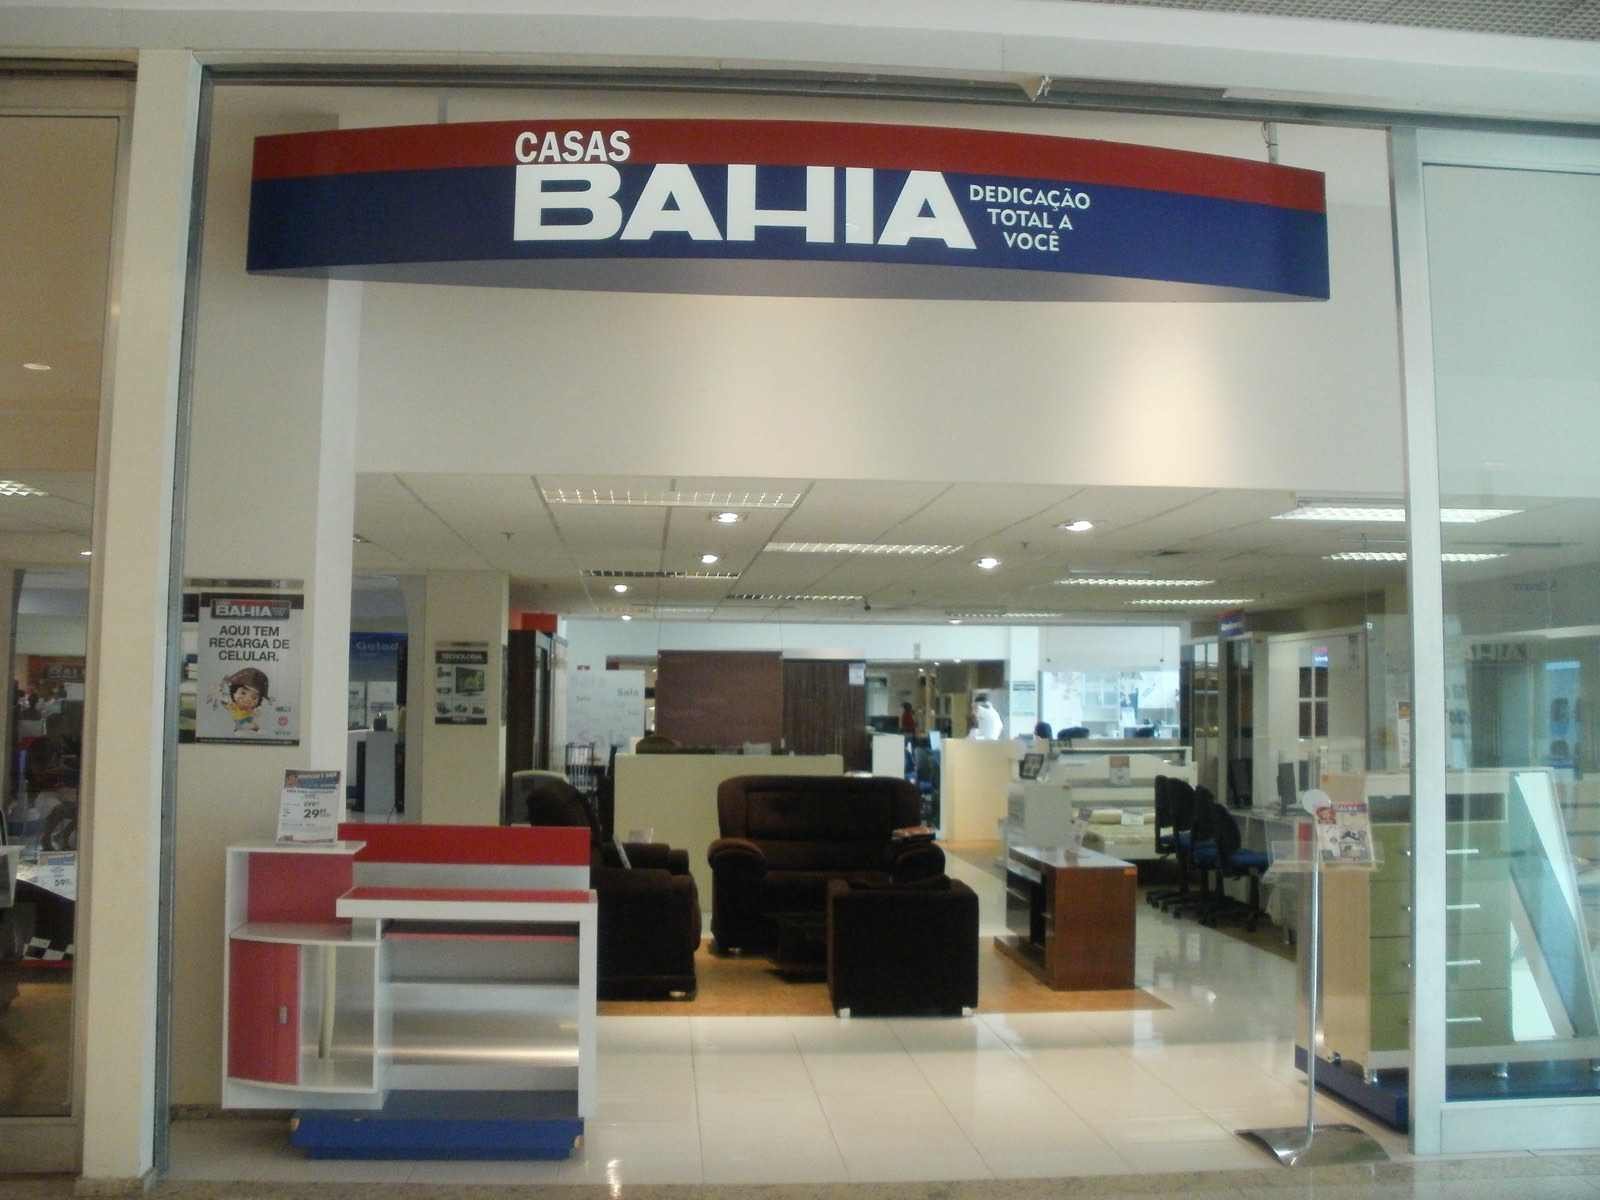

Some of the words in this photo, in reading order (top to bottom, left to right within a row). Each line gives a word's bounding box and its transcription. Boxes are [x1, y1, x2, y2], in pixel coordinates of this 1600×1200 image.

[515, 130, 631, 163] CASAS
[513, 163, 977, 250] BAHIA
[969, 184, 1091, 211] DEDICAÇÃO
[986, 208, 1054, 229] TOTAL
[1058, 213, 1073, 230] A
[1003, 230, 1061, 252] VOCÊ
[215, 605, 272, 617] BAHIA
[219, 624, 251, 637] AQUI
[253, 625, 281, 637] TEM
[208, 637, 270, 649] RECARGA
[272, 639, 290, 650] DE
[218, 650, 280, 662] CELULAR.
